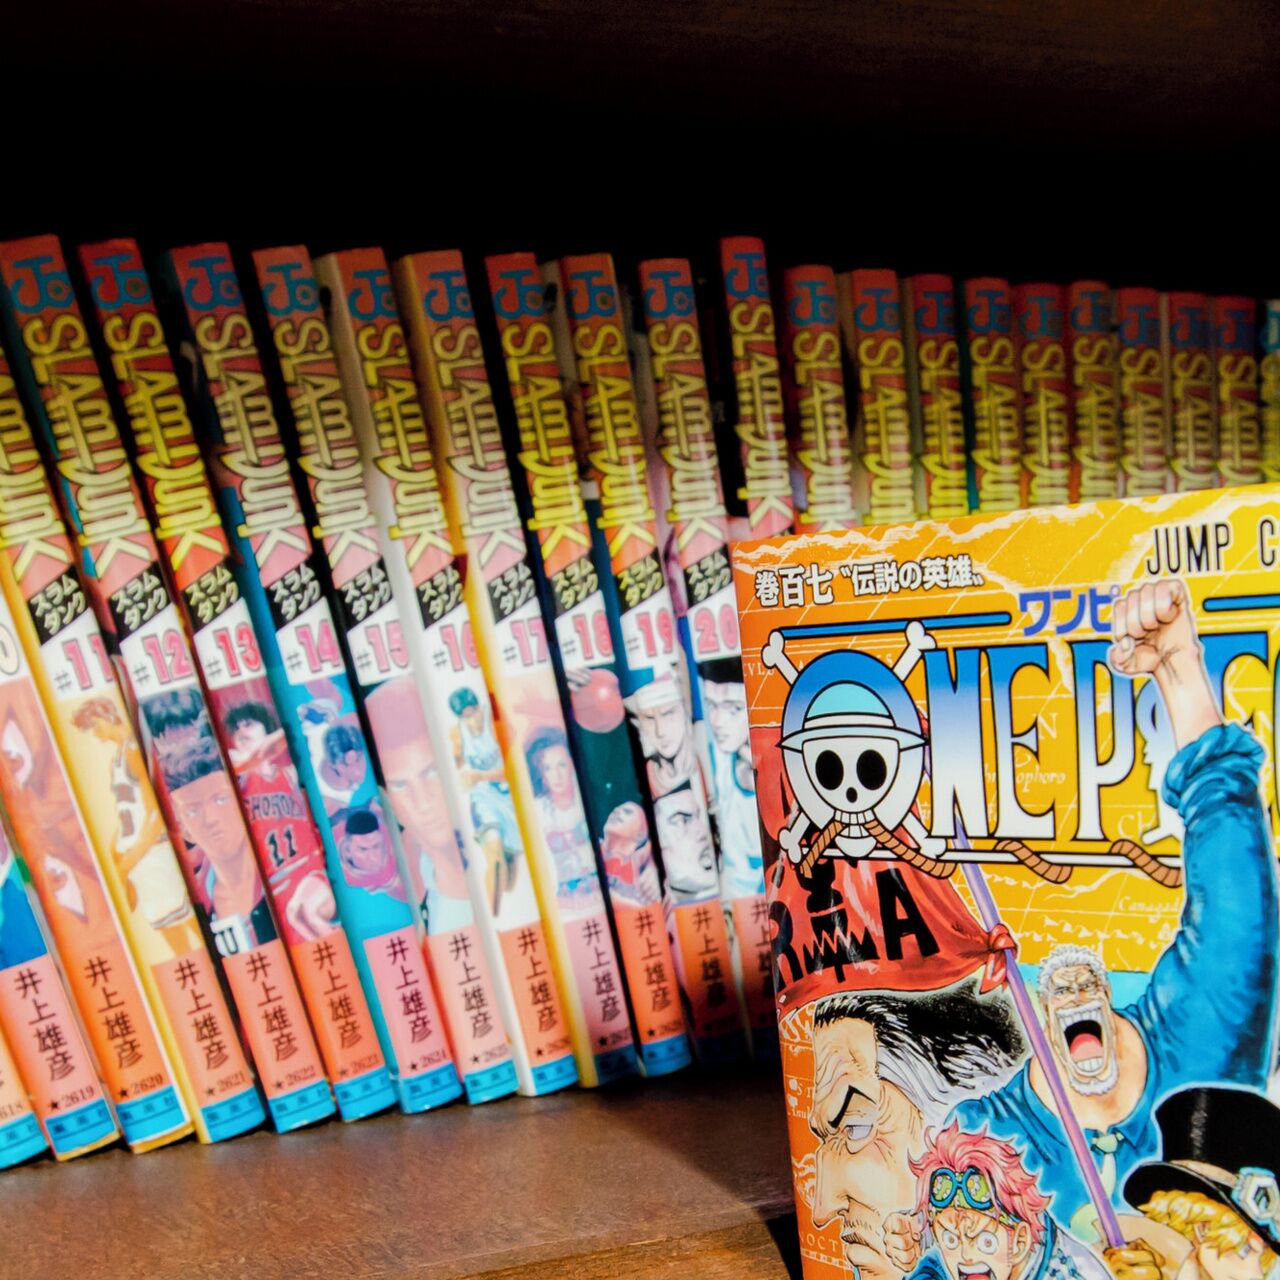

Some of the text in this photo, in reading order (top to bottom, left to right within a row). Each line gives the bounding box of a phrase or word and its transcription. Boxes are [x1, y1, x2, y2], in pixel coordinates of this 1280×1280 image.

[755, 564, 834, 607] 巻百七
[1146, 522, 1231, 575] JUMP
[83, 956, 142, 1069] 井上雄彦
[386, 937, 432, 1045] 井上雄彦
[449, 932, 493, 1040] 井上雄彦
[583, 918, 622, 1024] 井上雄彦
[14, 969, 74, 1083] 井上雄彦
